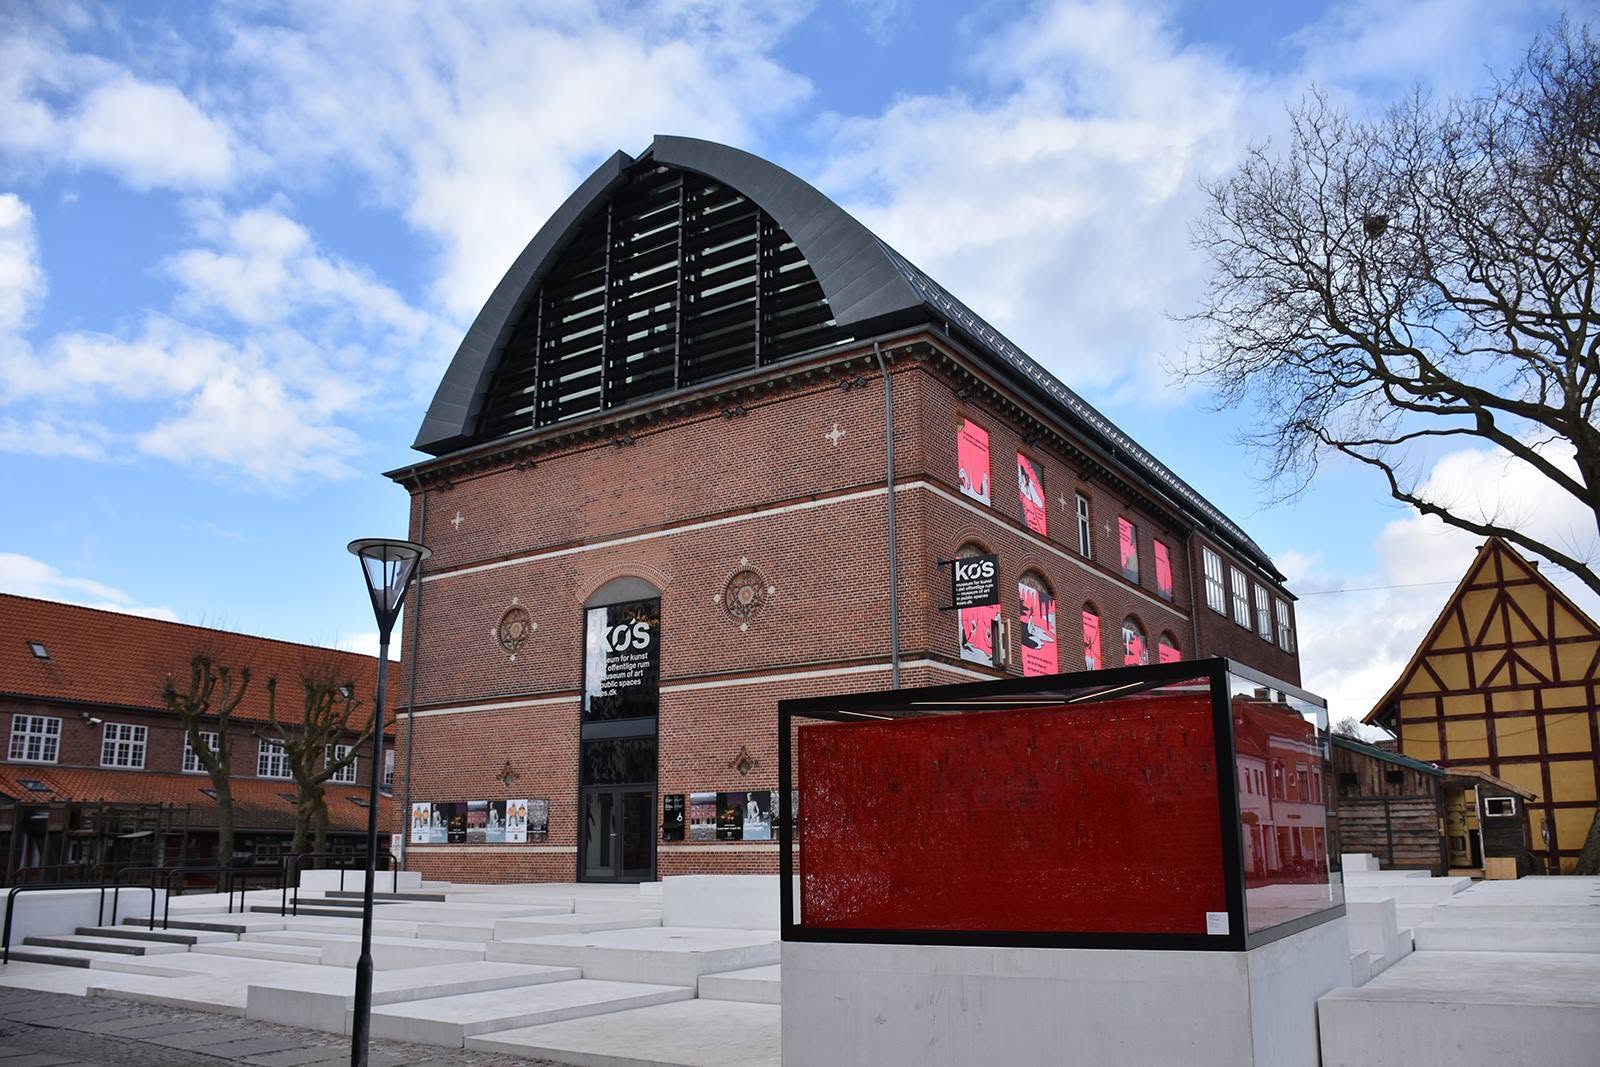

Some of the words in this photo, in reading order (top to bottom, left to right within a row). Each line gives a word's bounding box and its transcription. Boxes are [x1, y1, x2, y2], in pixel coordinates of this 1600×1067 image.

[620, 654, 629, 662] for
[630, 652, 648, 660] kunst
[607, 663, 637, 672] offentlige
[619, 679, 641, 687] spaces
